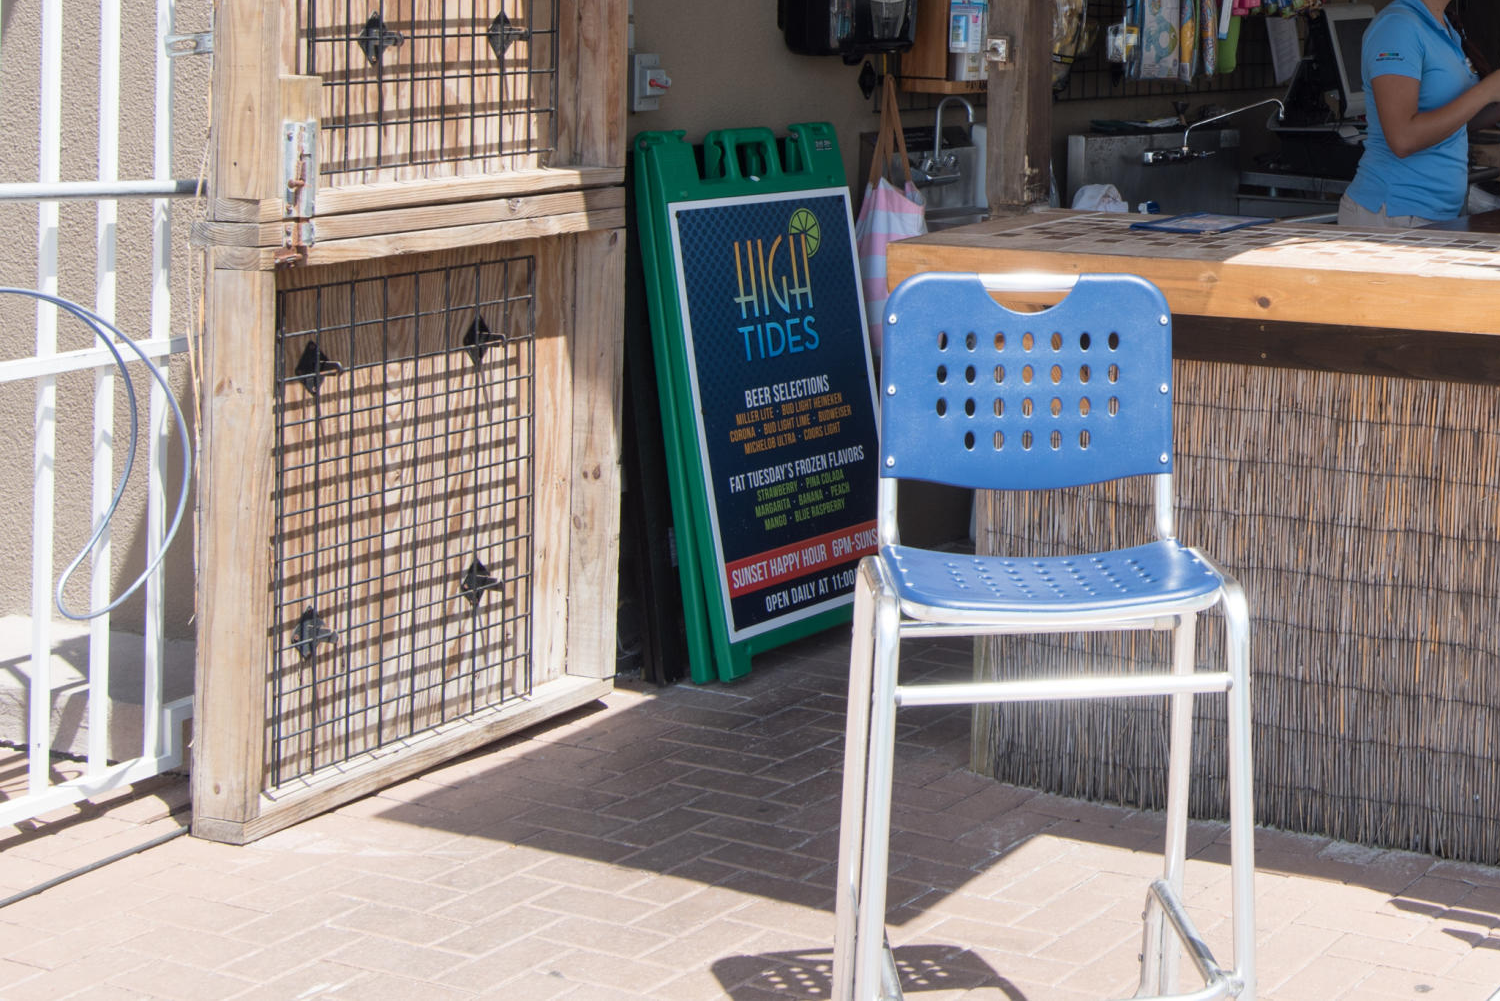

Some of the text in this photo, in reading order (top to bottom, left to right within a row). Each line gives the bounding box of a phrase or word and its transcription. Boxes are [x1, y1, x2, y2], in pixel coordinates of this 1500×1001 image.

[734, 234, 814, 319] HIGH
[737, 315, 819, 361] TIDES
[735, 392, 843, 426] MILLER LITE BUD LIGHT HEINEKEN
[744, 374, 830, 408] BEER SELECTIONS
[729, 404, 852, 443] CORONA BUD LIGHT LIME BUDWEISER
[744, 421, 841, 455] MICHELOB ULTRA COORS LIGHT
[729, 444, 865, 494] FAT TUESDAY'S FROZEN FLAVORS
[756, 481, 798, 502] STRAWBERRY
[821, 469, 845, 485] COLADA
[754, 481, 850, 518] MARGARITA BANANA PEACH
[764, 497, 845, 531] MANGO BLUE RASPBERRY
[731, 528, 879, 589] SUNSET HAPPY HOUR 6PM-SUNS
[765, 568, 857, 613] OPEN DAILY AT 11:00
